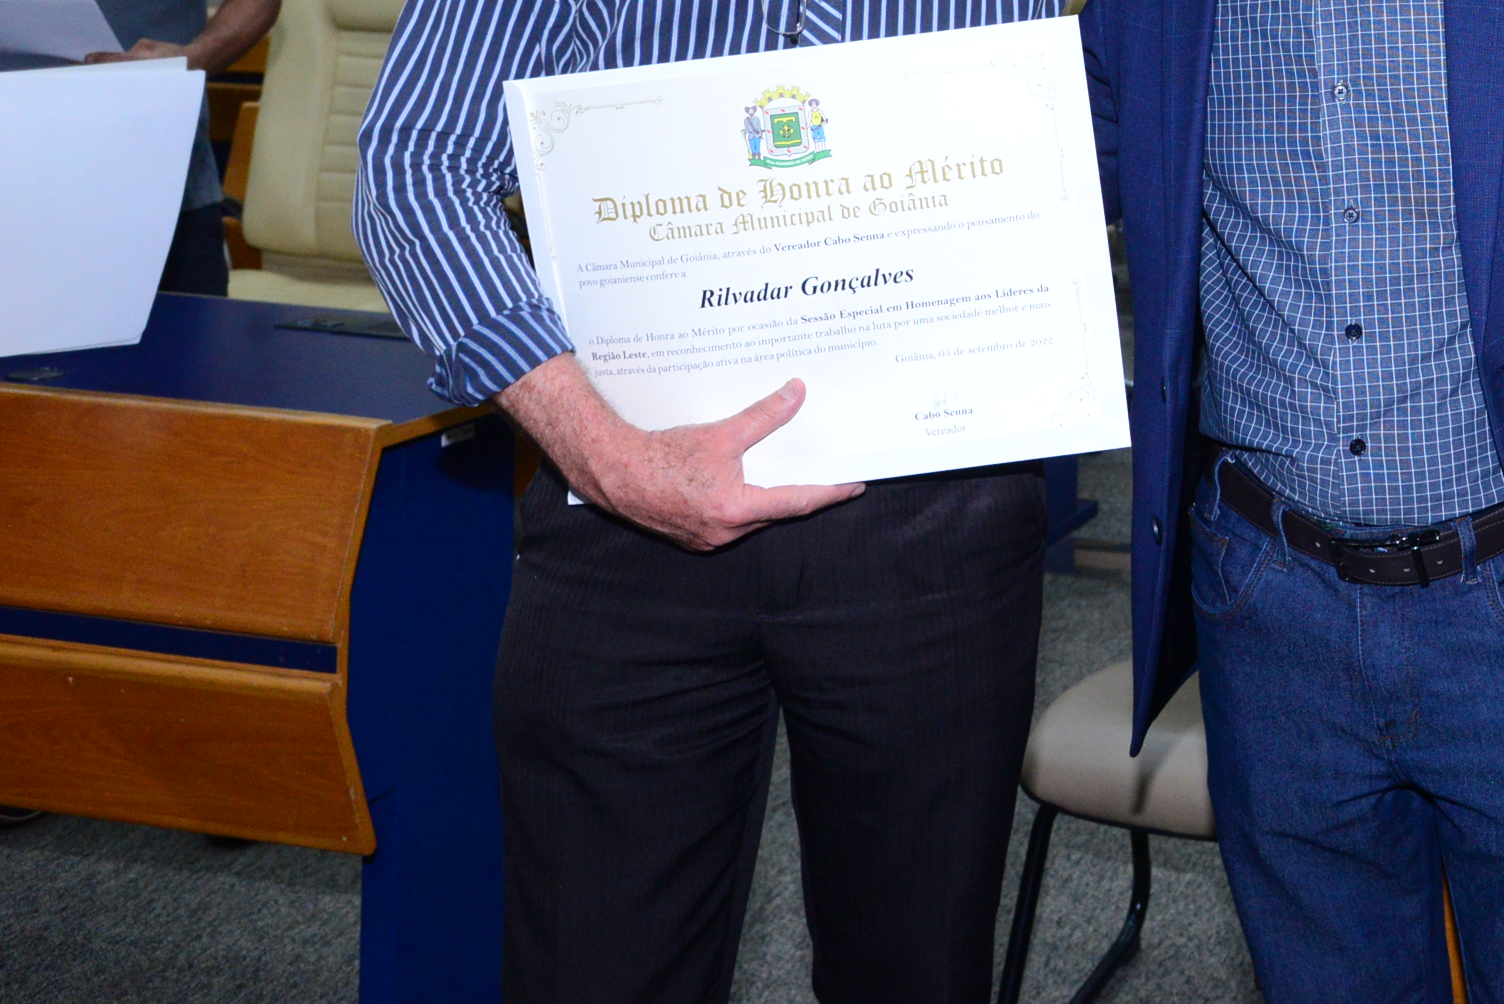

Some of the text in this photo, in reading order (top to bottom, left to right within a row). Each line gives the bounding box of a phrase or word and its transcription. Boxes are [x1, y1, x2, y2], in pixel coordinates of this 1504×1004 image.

[592, 155, 1004, 224] Diploma de Honra ao Mérito
[649, 191, 948, 242] Câmara Municipal de Goiânia
[576, 262, 584, 272] A
[585, 261, 618, 271] Câmara
[620, 254, 664, 268] Municipal
[667, 254, 677, 263] de
[680, 249, 720, 262] Goiânia,
[722, 245, 757, 257] através
[759, 244, 771, 253] do
[774, 238, 820, 252] Vereador
[824, 234, 851, 246] Cabo
[853, 232, 884, 242] Senna
[887, 230, 893, 238] e
[895, 220, 956, 238] expressando
[967, 212, 1025, 230] pensamento
[1027, 209, 1040, 219] do
[579, 278, 598, 289] povo
[600, 273, 645, 287] goianiense
[646, 270, 680, 280] confere
[700, 268, 914, 308] Rilvadar Gonçalves
[592, 350, 621, 363] Região
[623, 349, 649, 359] Leste,
[666, 340, 741, 355] reconhecimento
[744, 339, 755, 347] ao
[758, 331, 812, 346] importante
[815, 324, 856, 338] trabalho
[859, 324, 870, 332] na
[872, 320, 891, 330] luta
[894, 319, 910, 330] por
[913, 315, 934, 325] uma
[937, 307, 982, 322] sociedade
[985, 303, 1017, 315] melhor
[1021, 303, 1027, 311] e
[1029, 298, 1051, 309] mais
[596, 335, 630, 347] Diploma
[633, 332, 643, 342] de
[646, 331, 674, 341] Honra
[678, 330, 688, 338] ao
[691, 325, 725, 337] Mérito
[728, 324, 744, 336] por
[747, 317, 783, 330] ocasião
[786, 315, 798, 325] da
[800, 310, 836, 323] Sessão
[839, 304, 883, 319] Especial
[886, 304, 902, 312] em
[906, 295, 971, 310] Homenagem
[975, 292, 992, 301] aos
[995, 286, 1034, 298] Líderes
[1037, 283, 1049, 293] da
[616, 364, 646, 375] através
[646, 363, 656, 373] da
[658, 358, 713, 375] participação
[715, 356, 738, 366] ativa
[740, 355, 752, 363] na
[753, 352, 774, 361] área
[776, 346, 812, 361] política
[813, 343, 826, 353] do
[895, 350, 936, 363] Goiânia,
[953, 346, 966, 356] de
[968, 340, 1013, 354] setembro
[1015, 338, 1027, 348] de
[914, 407, 973, 421] Cabo Senna
[925, 423, 967, 437] Vereador
